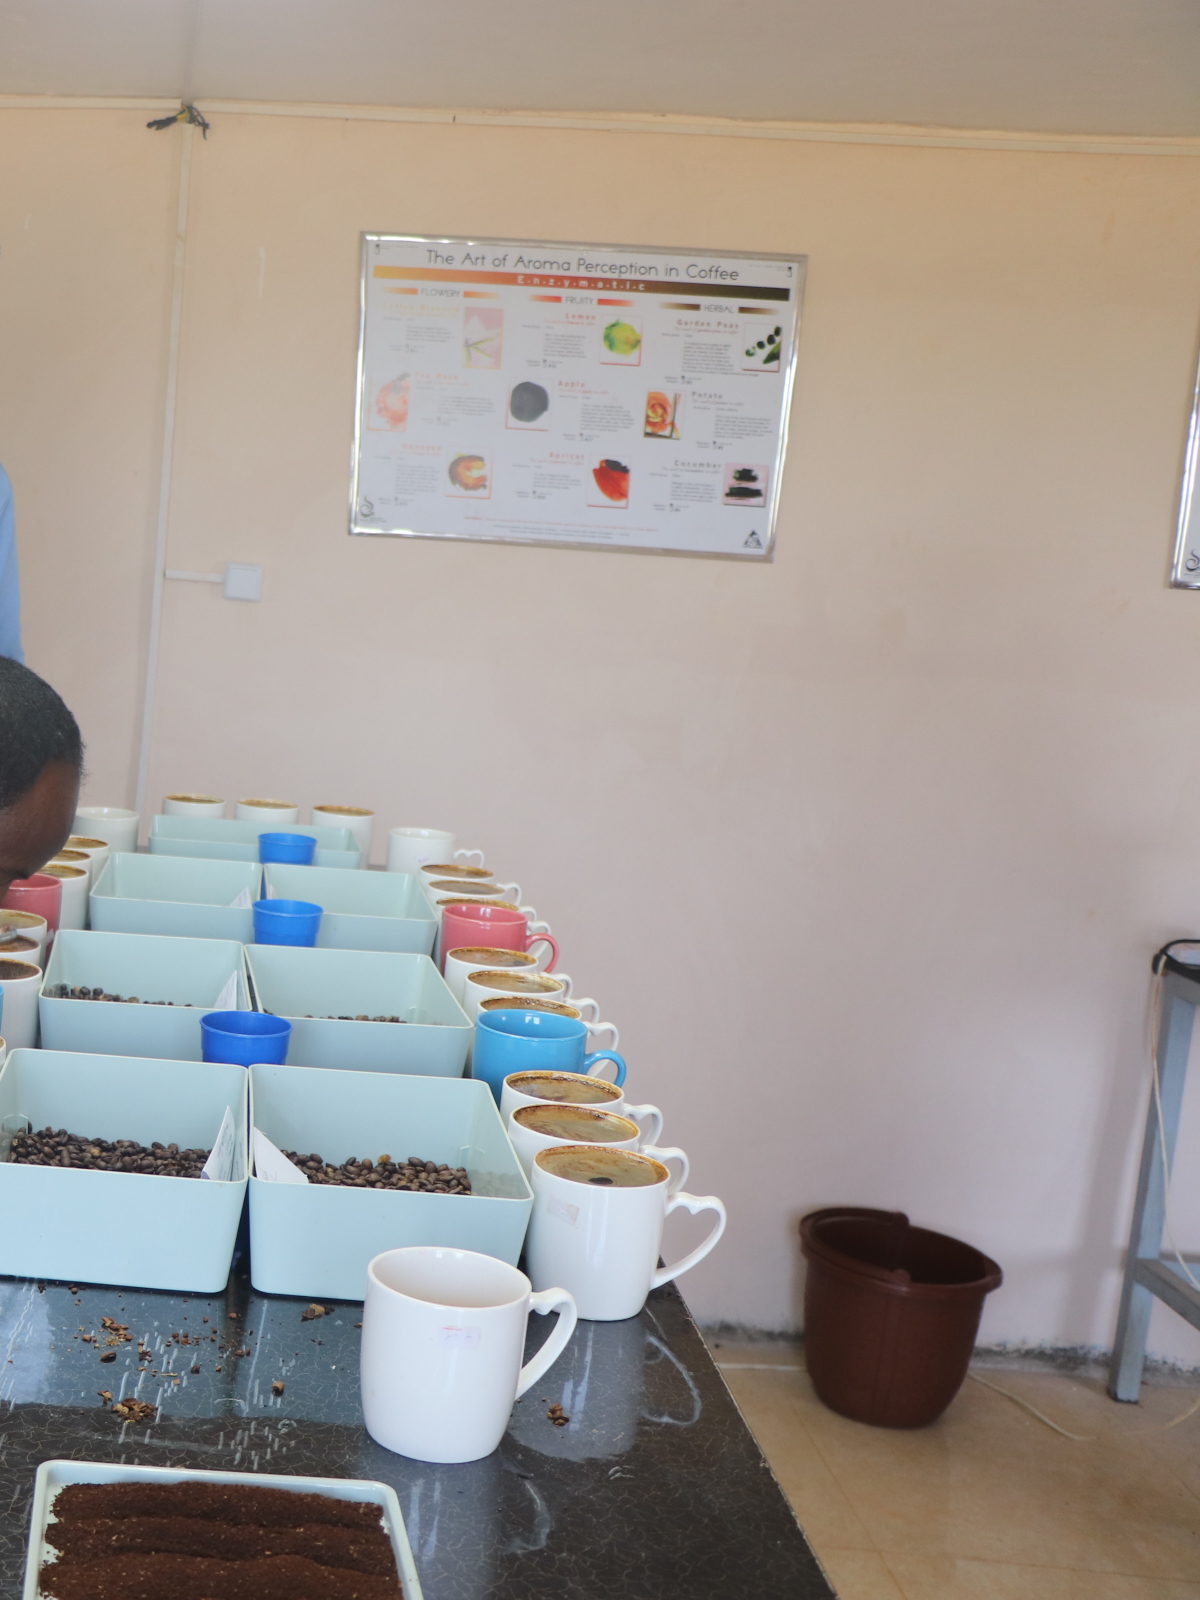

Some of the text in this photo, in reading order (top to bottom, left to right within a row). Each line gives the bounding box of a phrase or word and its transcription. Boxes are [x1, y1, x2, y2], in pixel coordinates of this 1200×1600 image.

[426, 249, 740, 281] The Art of Aroma Perception in Coffee
[421, 288, 461, 298] FLOWERY
[565, 296, 595, 305] FRUITY
[703, 304, 734, 314] HERBAL
[566, 313, 596, 321] Lemon
[676, 319, 739, 329] Garden Peas
[558, 380, 585, 388] Apple
[549, 452, 585, 460] Apricot
[674, 460, 722, 469] Cucumber
